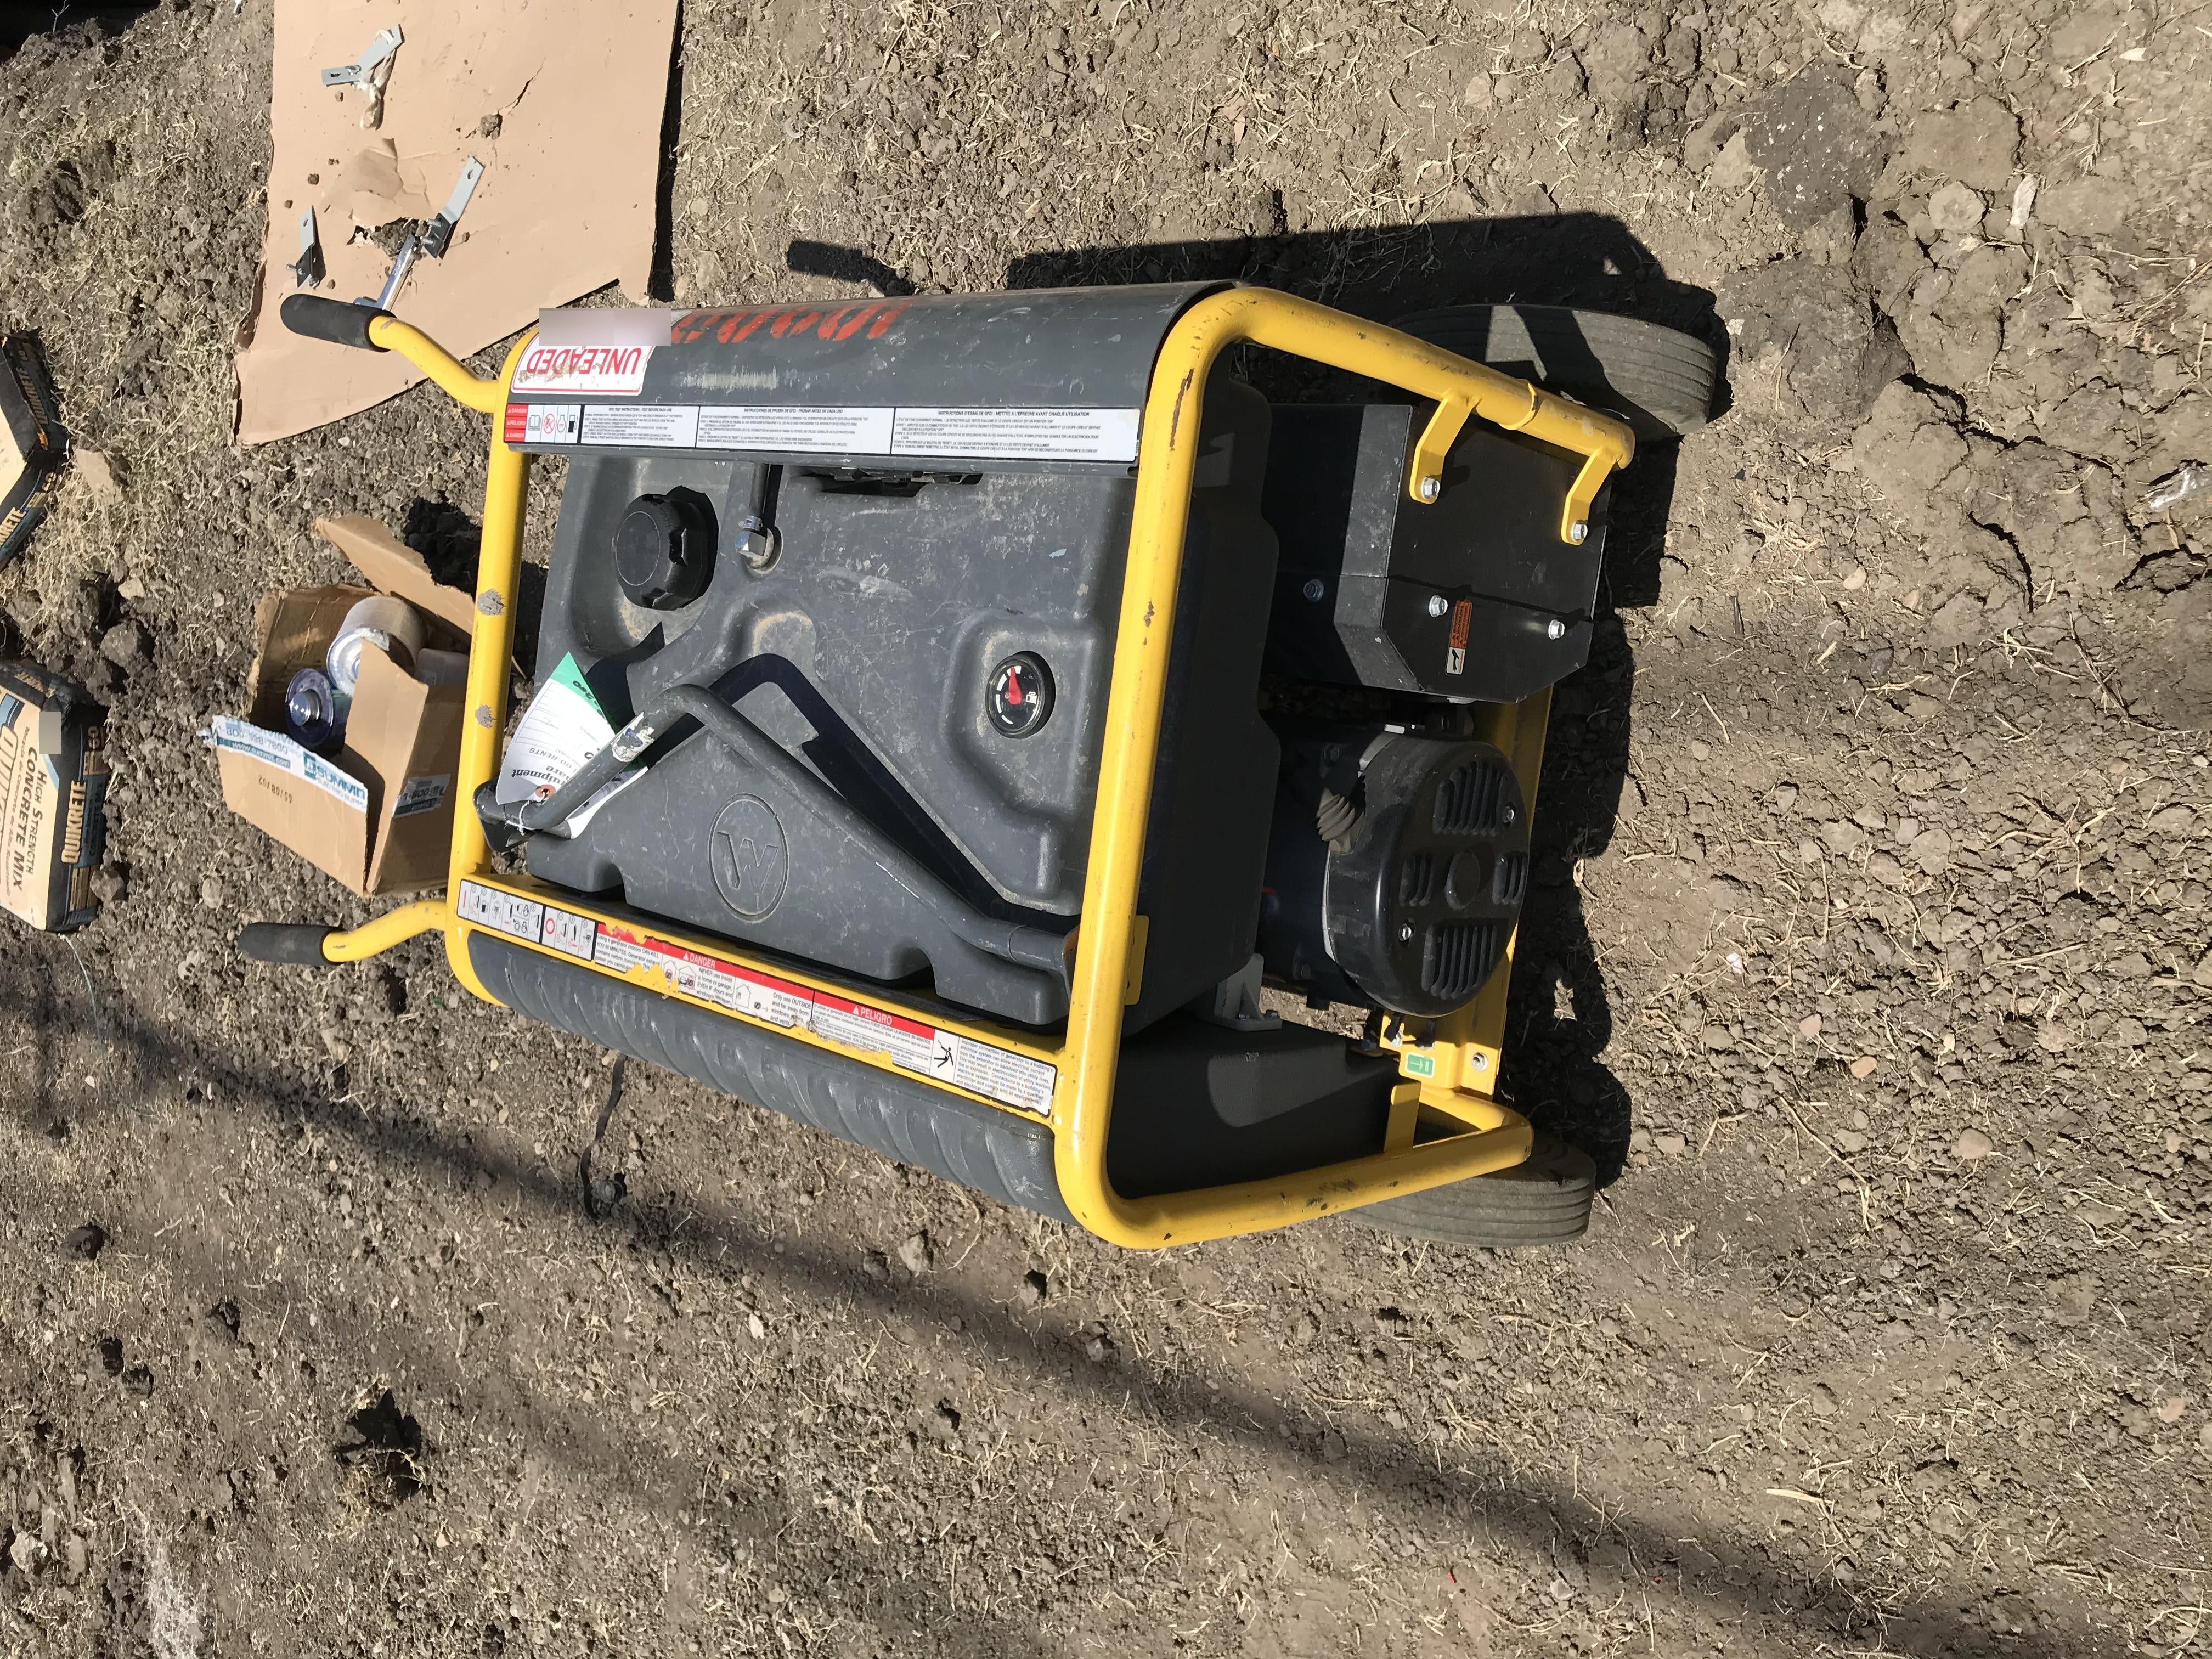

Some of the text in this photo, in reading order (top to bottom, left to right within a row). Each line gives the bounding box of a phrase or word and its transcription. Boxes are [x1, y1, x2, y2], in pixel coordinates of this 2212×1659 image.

[527, 348, 641, 375] UNLEADED
[0, 506, 26, 546] KRETE
[13, 746, 38, 893] CONCRETE MIX
[26, 769, 48, 875] HIGH STRENGTH
[61, 780, 86, 864] QUIKRETE
[597, 933, 607, 942] Using
[611, 938, 627, 949] generator
[610, 945, 627, 956] MINUTES.
[628, 951, 645, 962] Generator
[690, 953, 715, 969] DANGER
[698, 967, 712, 976] NEVER
[721, 974, 732, 983] inside
[701, 975, 712, 984] home
[697, 981, 708, 990] EVEN
[773, 992, 782, 1001] Only
[791, 997, 811, 1009] OUTSIDE
[787, 1006, 798, 1014] away
[861, 1007, 893, 1026] PELIGRO
[961, 1039, 978, 1048] Improper
[979, 1045, 1000, 1055] connection
[1005, 1053, 1024, 1063] generator
[960, 1045, 977, 1054] electrical
[978, 1051, 991, 1059] system
[1012, 1061, 1029, 1071] electrical
[1030, 1068, 1045, 1076] current
[976, 1056, 994, 1066] generator
[1000, 1064, 1018, 1073] backfeed
[957, 1068, 974, 1076] electrical
[975, 1074, 989, 1082] system
[991, 1073, 1015, 1084] Connections
[992, 1067, 1017, 1079] electrocution
[964, 1081, 981, 1091] electrical
